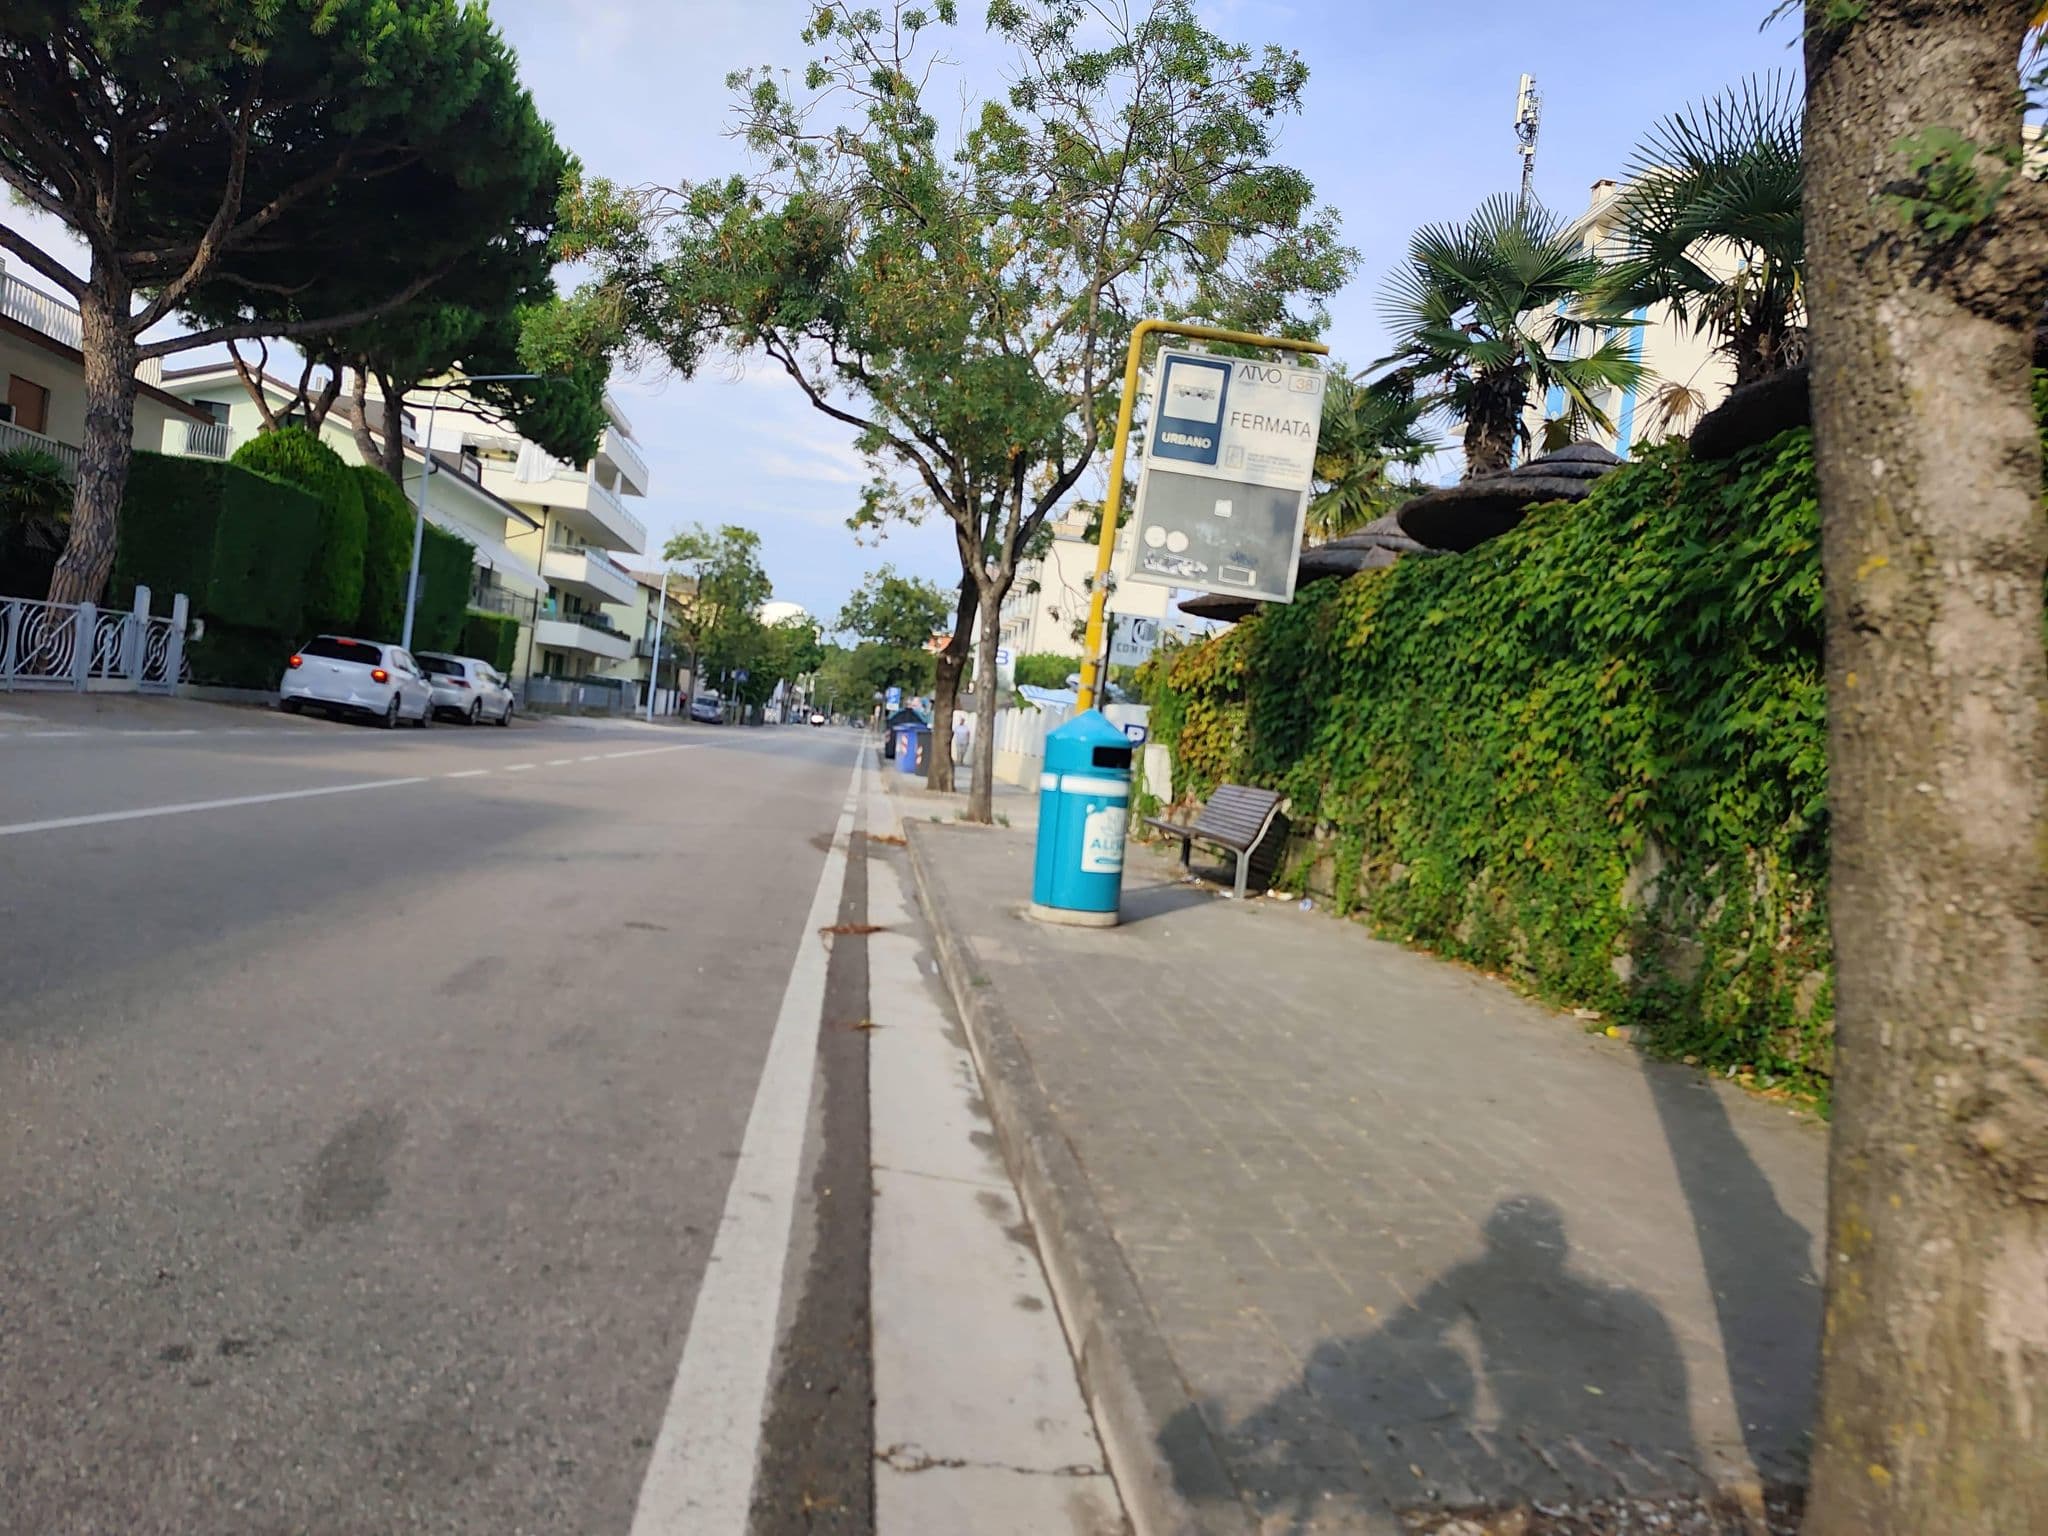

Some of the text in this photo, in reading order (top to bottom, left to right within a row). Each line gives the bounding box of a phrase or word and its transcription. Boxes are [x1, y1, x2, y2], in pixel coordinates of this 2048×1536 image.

[1239, 365, 1282, 384] ATVO
[1230, 411, 1312, 438] FERMATA
[1161, 431, 1212, 449] URBANO
